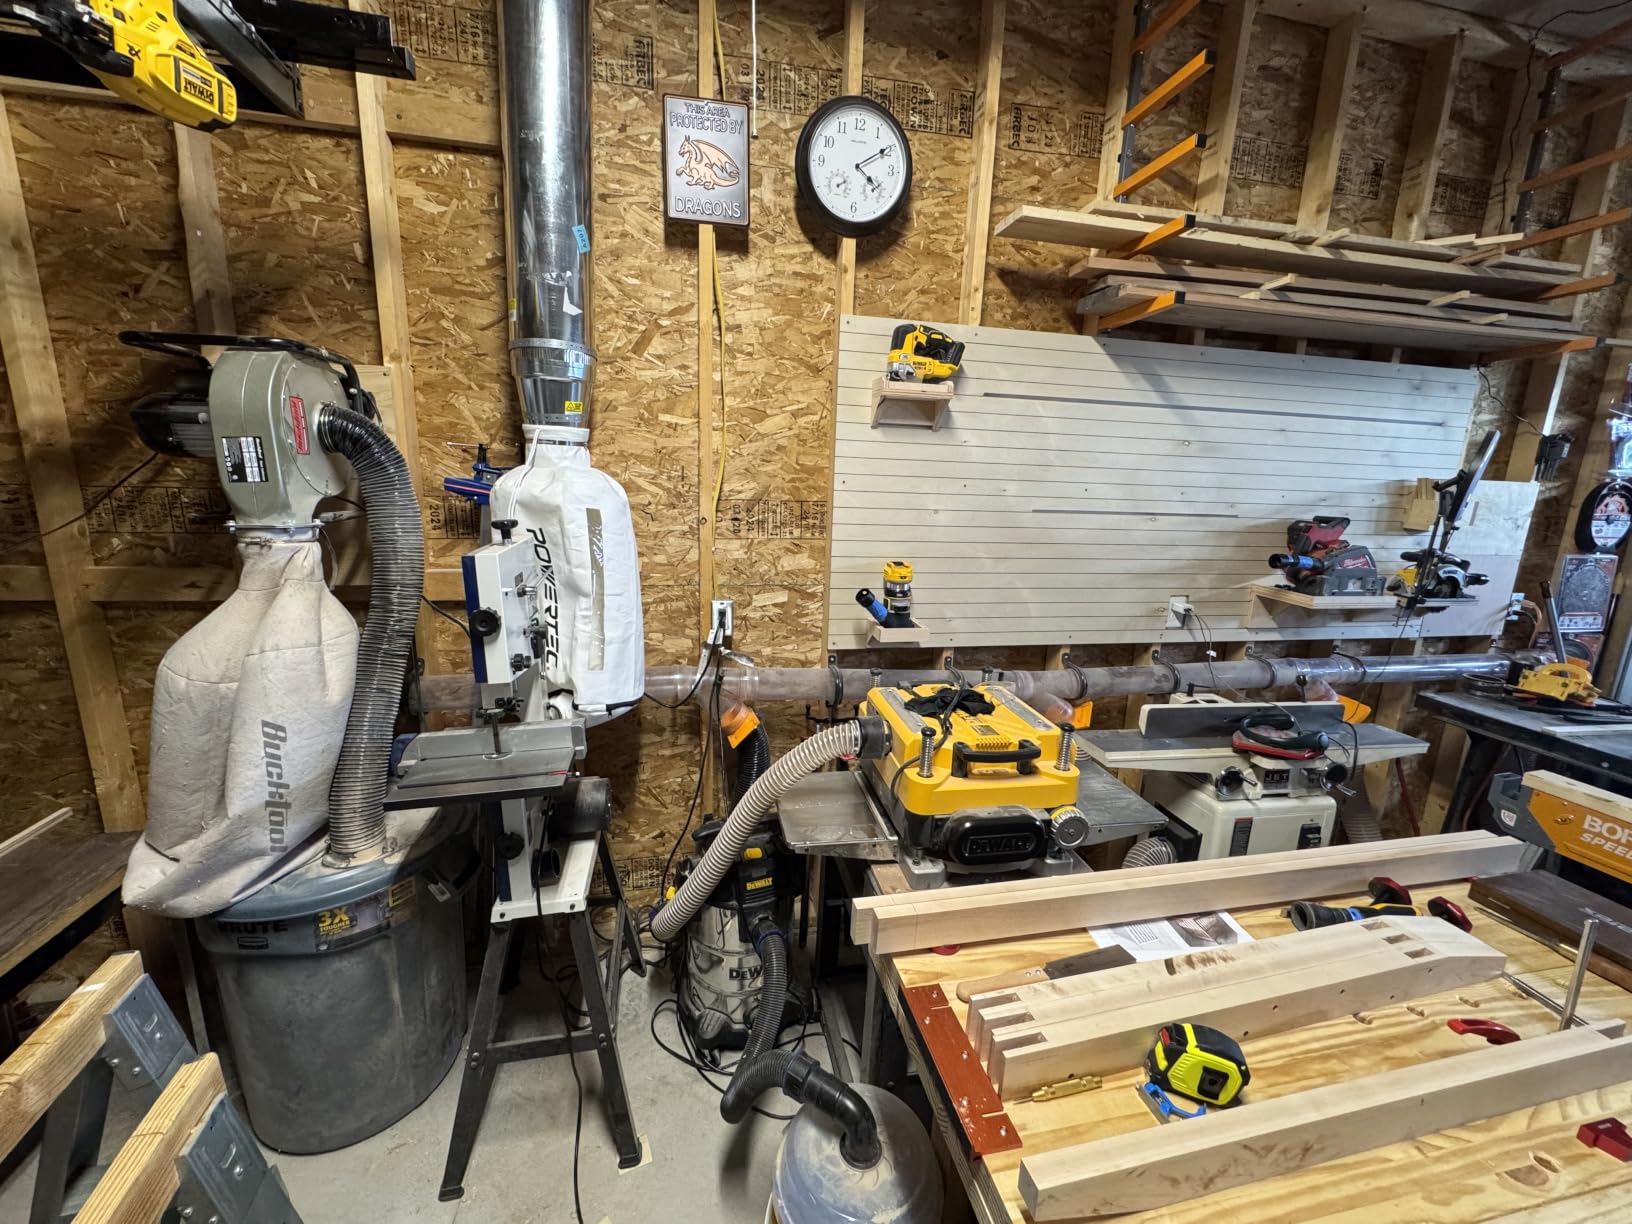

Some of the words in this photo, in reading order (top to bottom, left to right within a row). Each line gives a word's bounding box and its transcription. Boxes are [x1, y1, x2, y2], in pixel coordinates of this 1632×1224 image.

[183, 79, 215, 105] DEWALT
[684, 102, 705, 115] THIS
[705, 104, 731, 118] AREA
[910, 85, 919, 129] DOWN
[669, 111, 729, 133] PROTECTED
[729, 119, 743, 135] BY
[837, 120, 847, 134] 11
[854, 117, 866, 131] 12
[875, 126, 880, 139] 1
[823, 135, 835, 149] 10
[884, 145, 892, 157] 2
[817, 154, 825, 167] 9
[887, 164, 895, 176] 3
[674, 195, 741, 218] DRAGONS
[850, 201, 857, 213] 6
[429, 504, 441, 532] 2024
[746, 507, 755, 532] 2024
[526, 527, 560, 670] POWERTEC
[1265, 773, 1288, 781] JET
[261, 719, 293, 853] Bucktool
[746, 877, 773, 891] DEWALT
[318, 906, 350, 927] 3X
